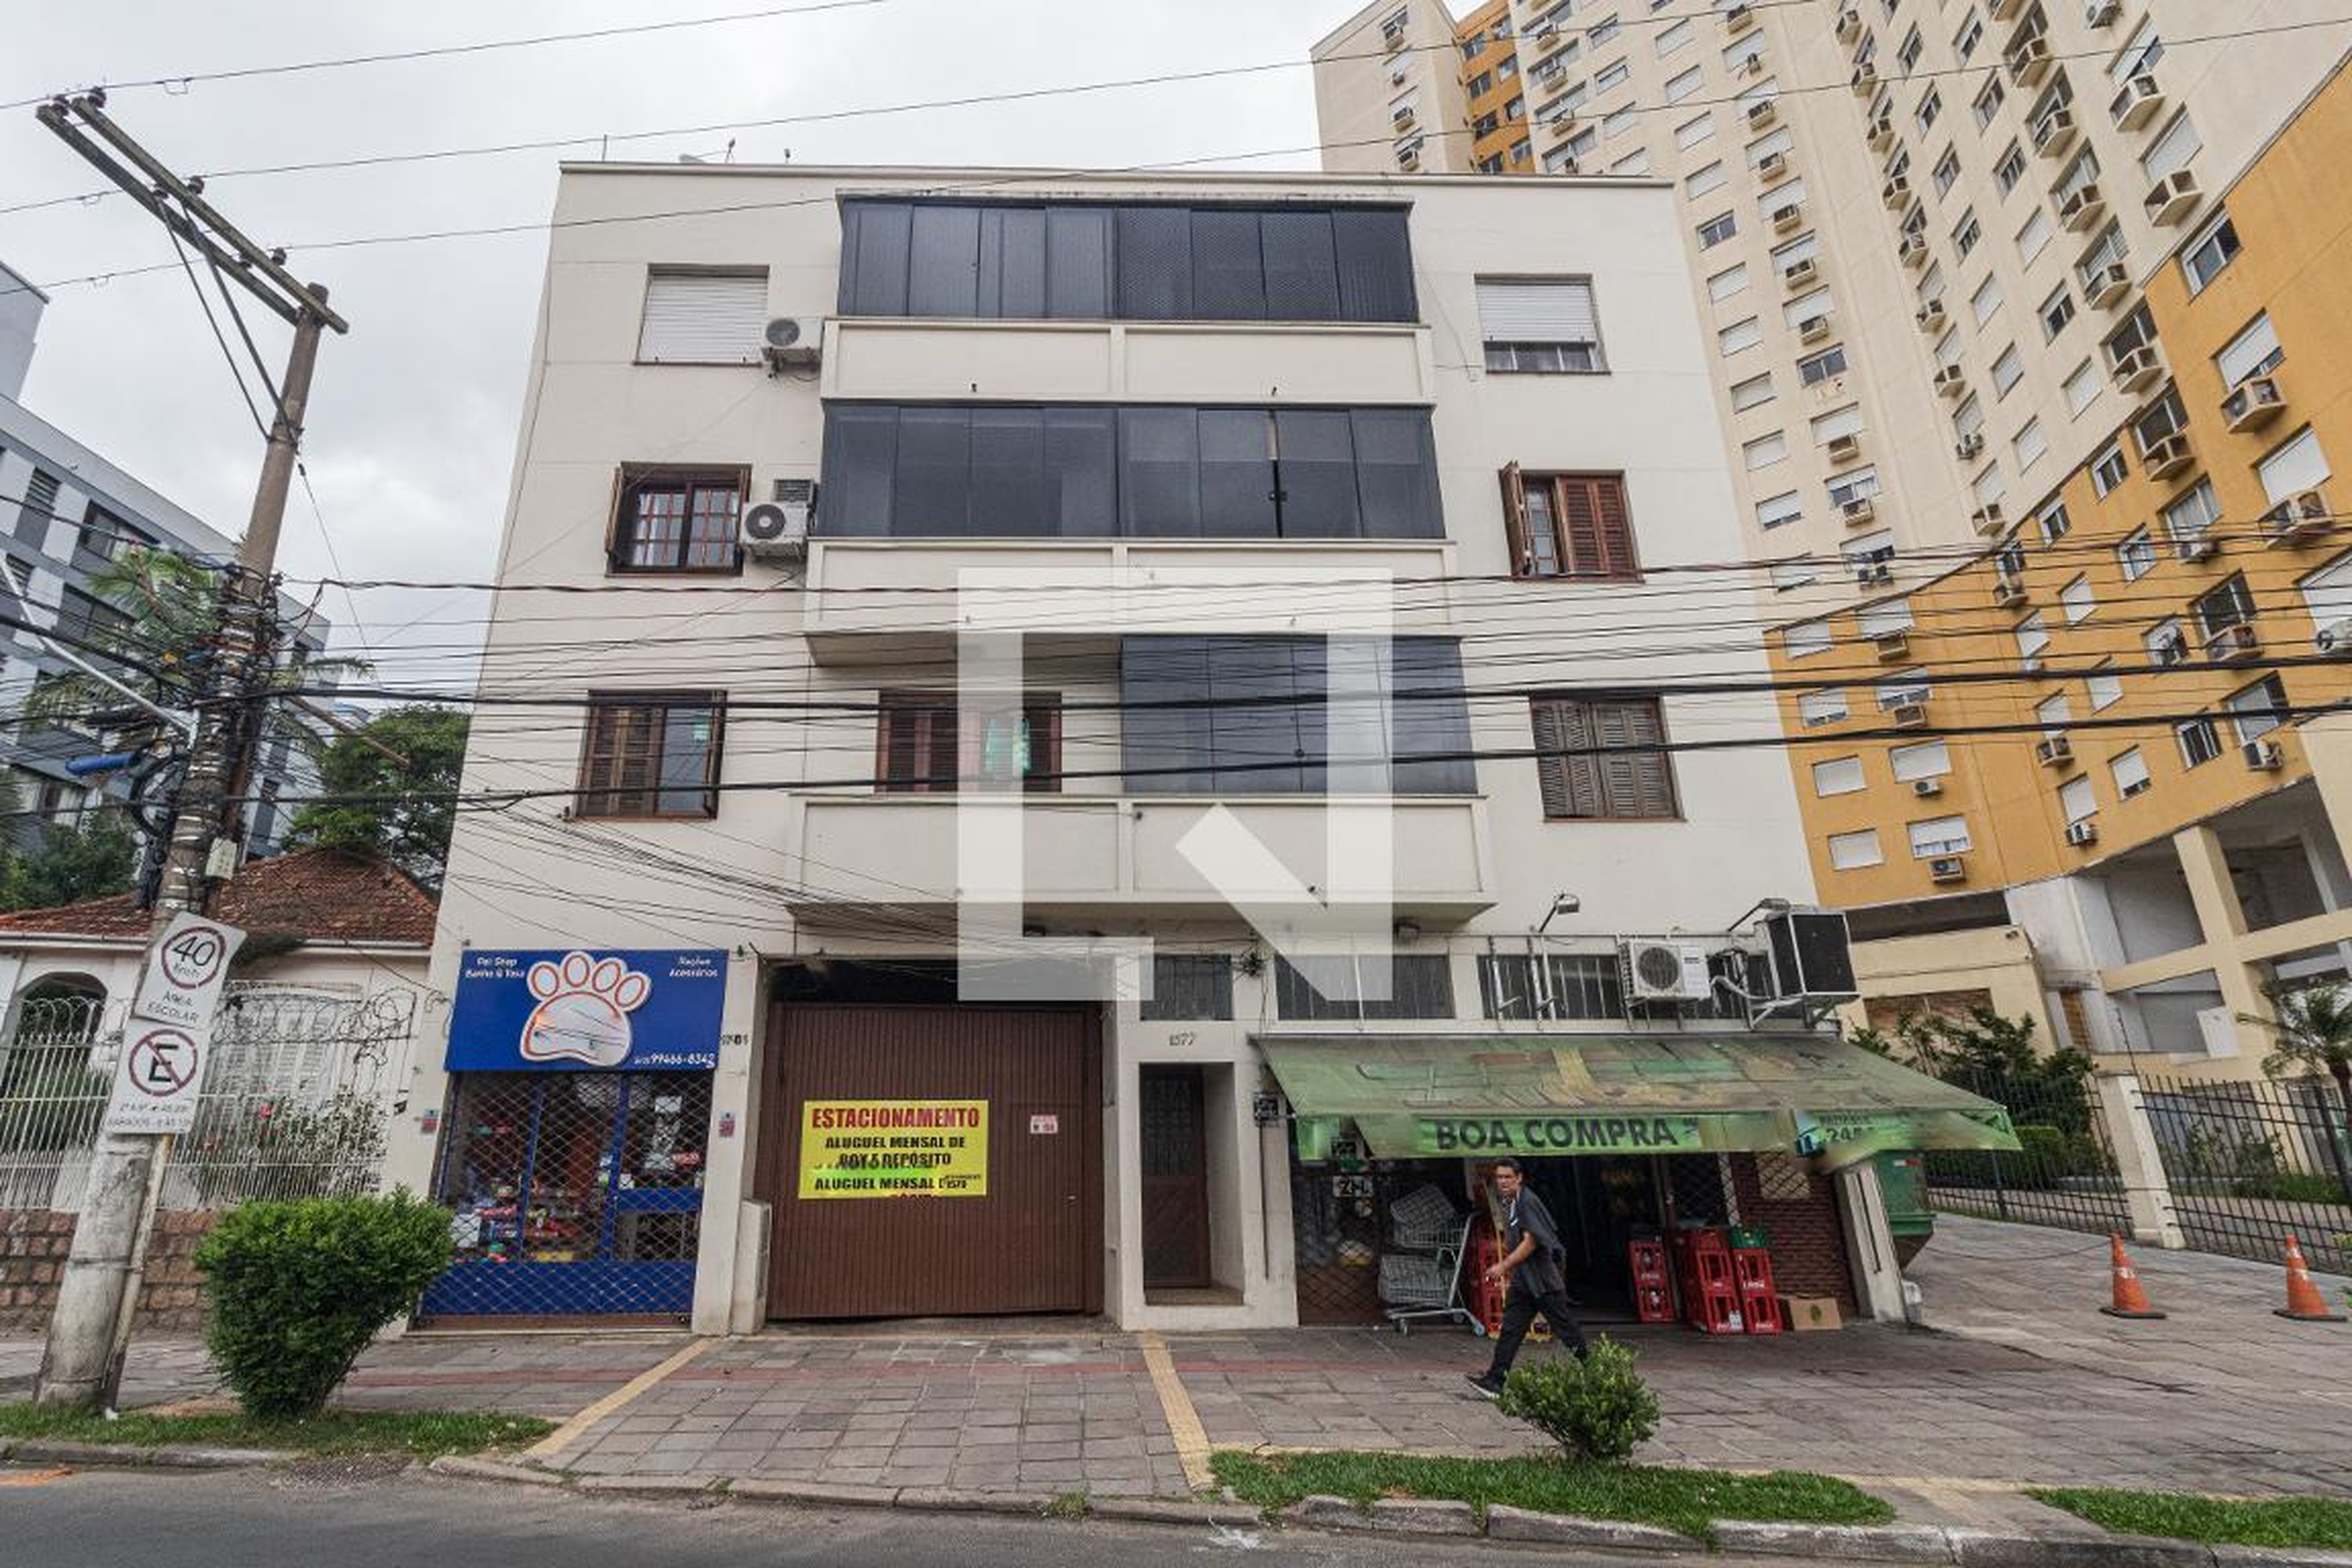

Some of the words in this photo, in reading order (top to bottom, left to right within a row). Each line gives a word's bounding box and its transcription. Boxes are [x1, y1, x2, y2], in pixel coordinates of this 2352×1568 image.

[171, 936, 216, 966] 40
[146, 1001, 199, 1023] ESCOLAR
[812, 1107, 980, 1128] ESTACIONAMENTO
[825, 1136, 886, 1148] ALUGUEL
[889, 1136, 946, 1148] MENSAL
[948, 1136, 965, 1148] DE
[1436, 1120, 1513, 1150] BOA
[1523, 1118, 1678, 1148] COMPRA
[815, 1177, 875, 1190] ALUGUEL
[880, 1177, 935, 1189] MENSAL
